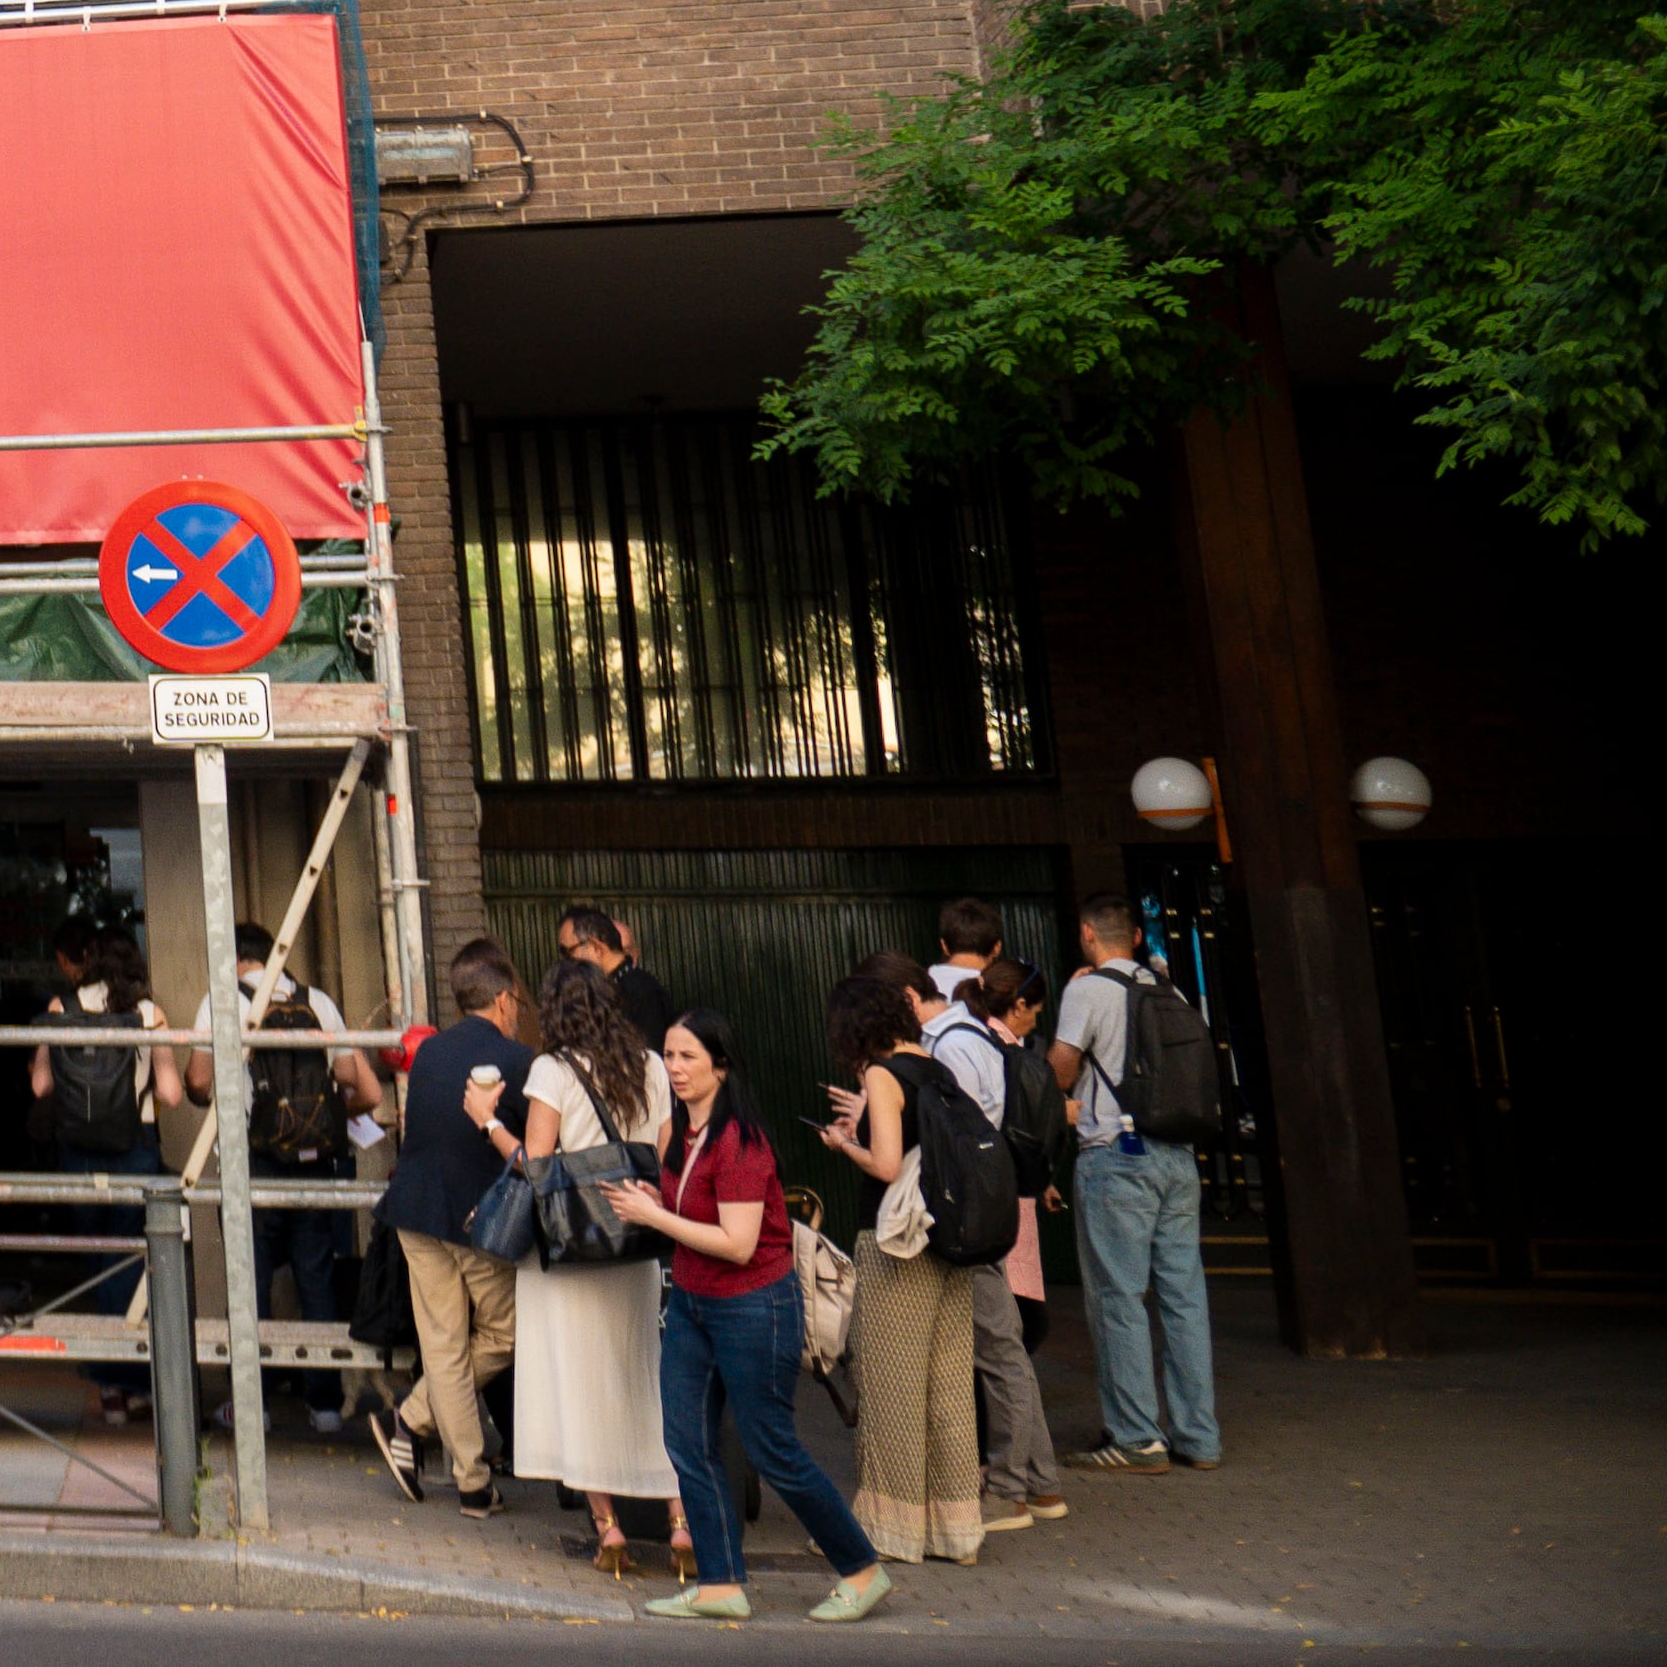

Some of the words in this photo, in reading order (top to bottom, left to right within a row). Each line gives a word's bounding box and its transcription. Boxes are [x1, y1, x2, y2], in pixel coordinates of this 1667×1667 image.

[173, 692, 219, 706] ZONA
[226, 691, 248, 705] DE
[165, 711, 260, 728] SEGURIDAD
